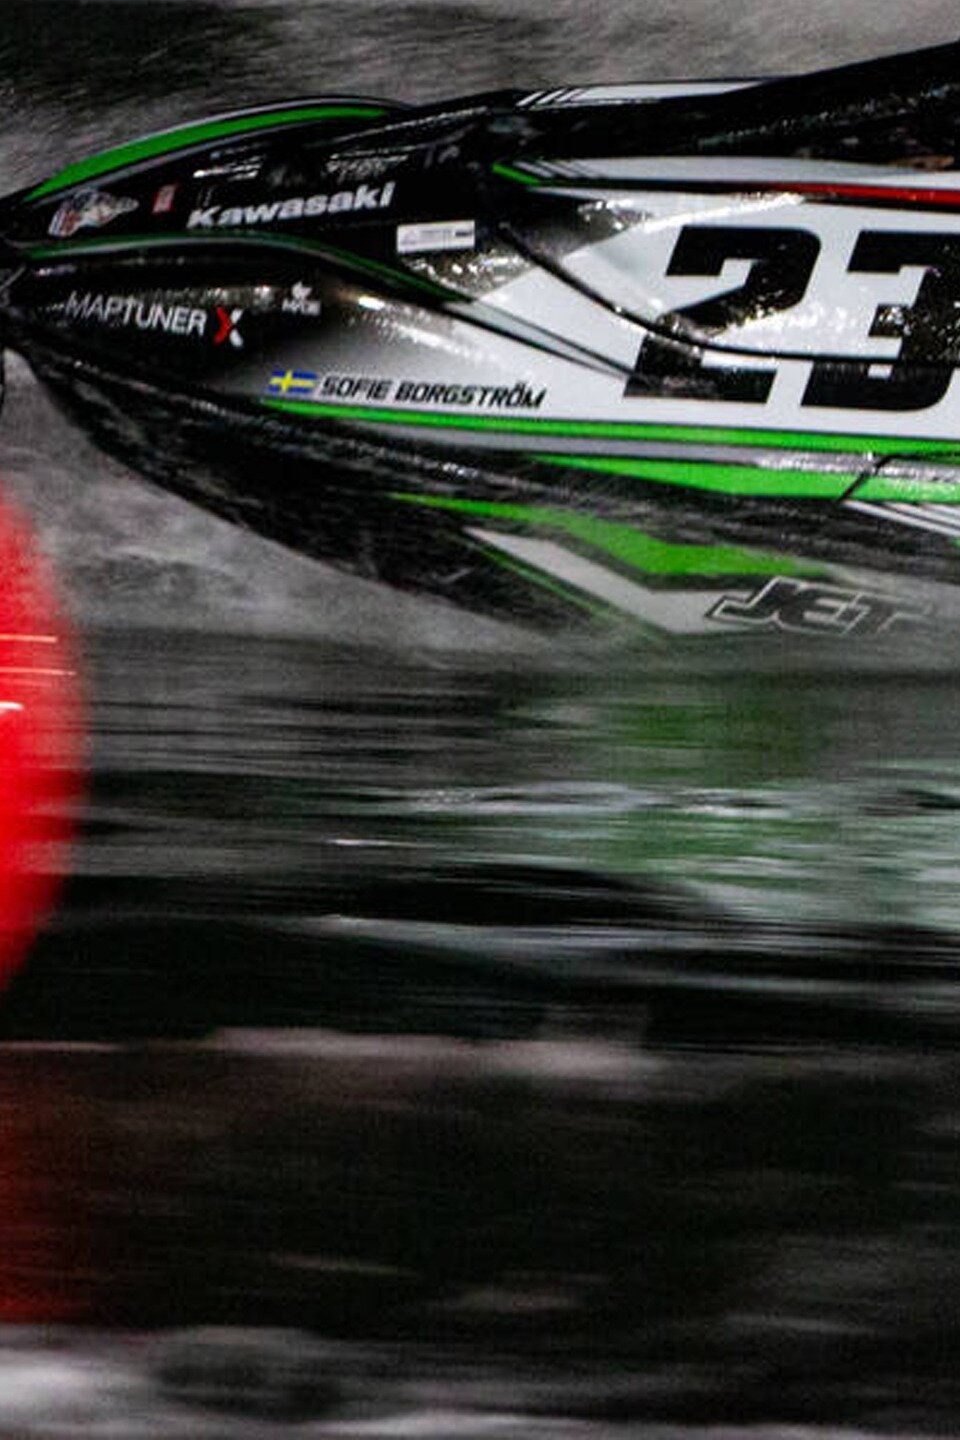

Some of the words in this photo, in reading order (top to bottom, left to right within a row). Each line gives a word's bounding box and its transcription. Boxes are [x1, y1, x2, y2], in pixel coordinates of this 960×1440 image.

[186, 181, 396, 229] Kawasaki
[63, 291, 207, 335] MAPTUNER
[212, 305, 244, 348] X
[320, 374, 391, 401] SOFIE
[395, 379, 547, 409] BORGSTRÖM
